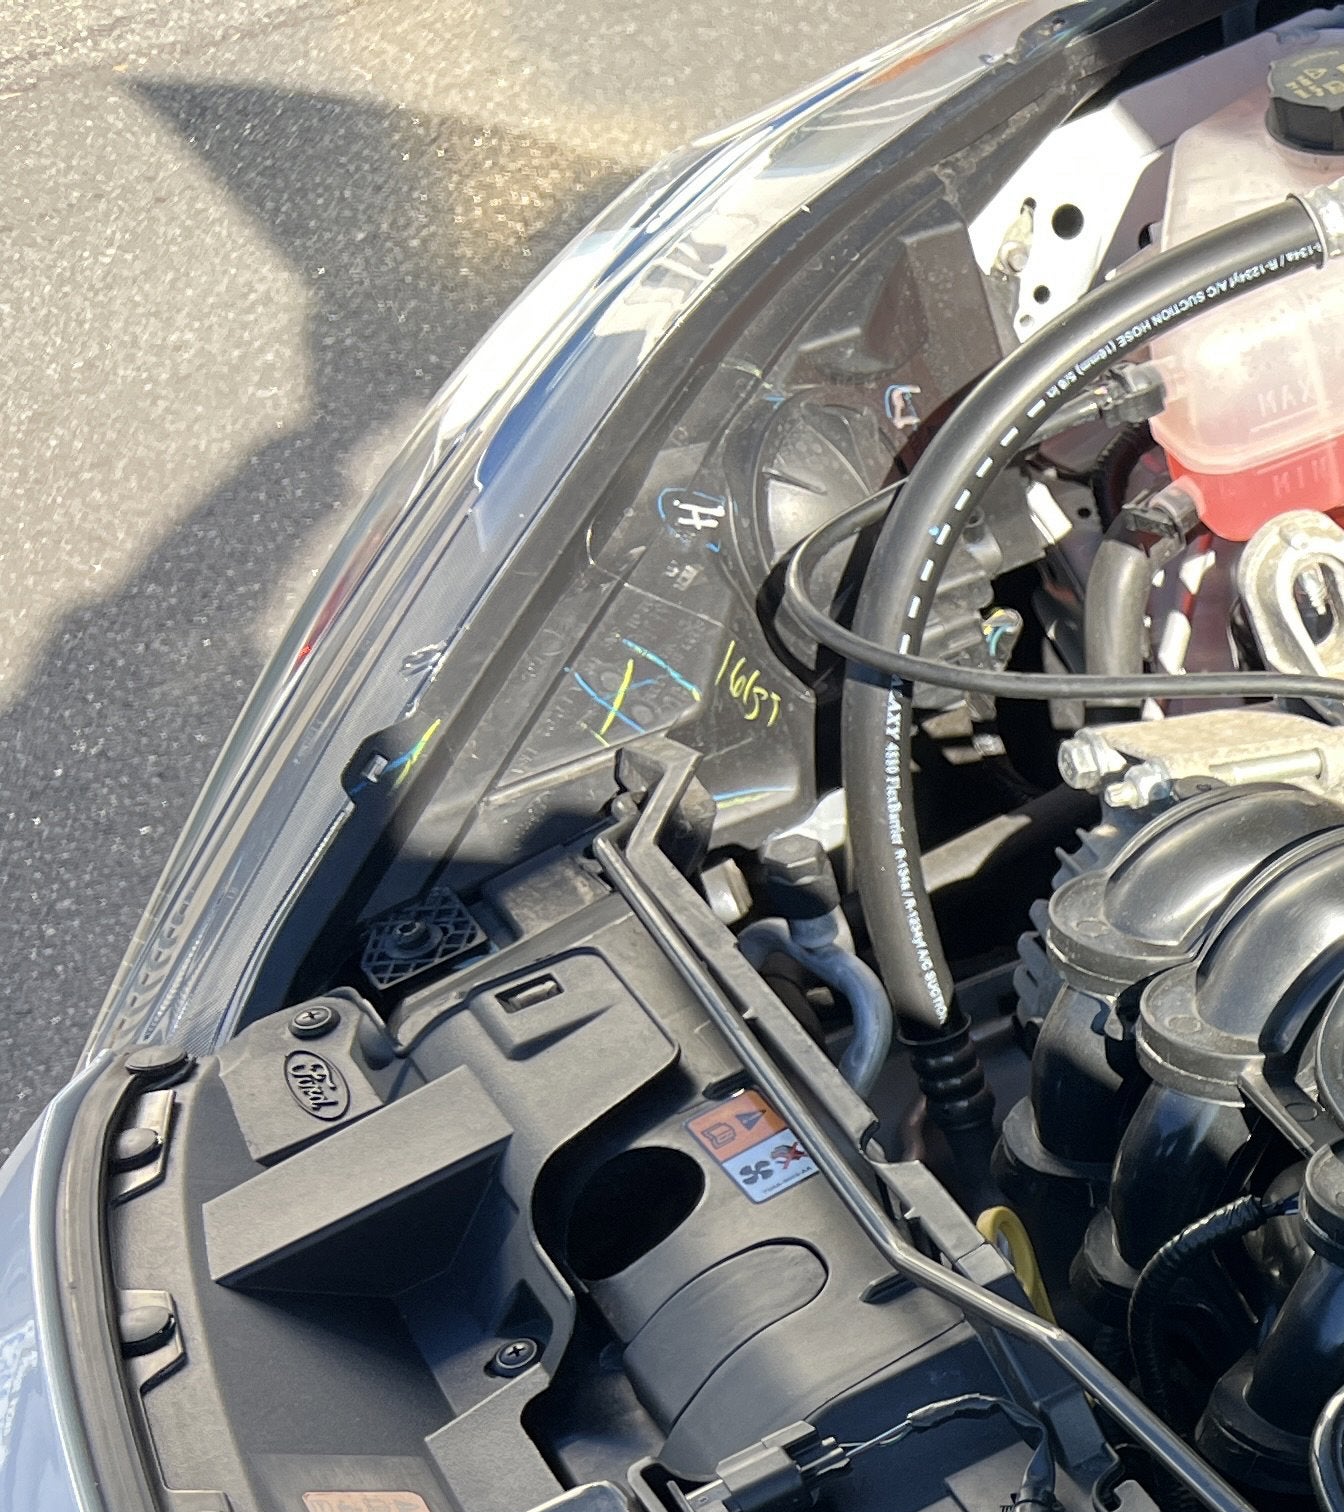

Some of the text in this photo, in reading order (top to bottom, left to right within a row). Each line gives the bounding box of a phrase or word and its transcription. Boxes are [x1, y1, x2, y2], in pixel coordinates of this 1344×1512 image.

[1204, 278, 1228, 298] A/C
[1149, 289, 1206, 326] SUCTION
[1114, 318, 1153, 347] HOSE
[1257, 376, 1313, 416] MAX
[292, 1060, 338, 1111] Ford
